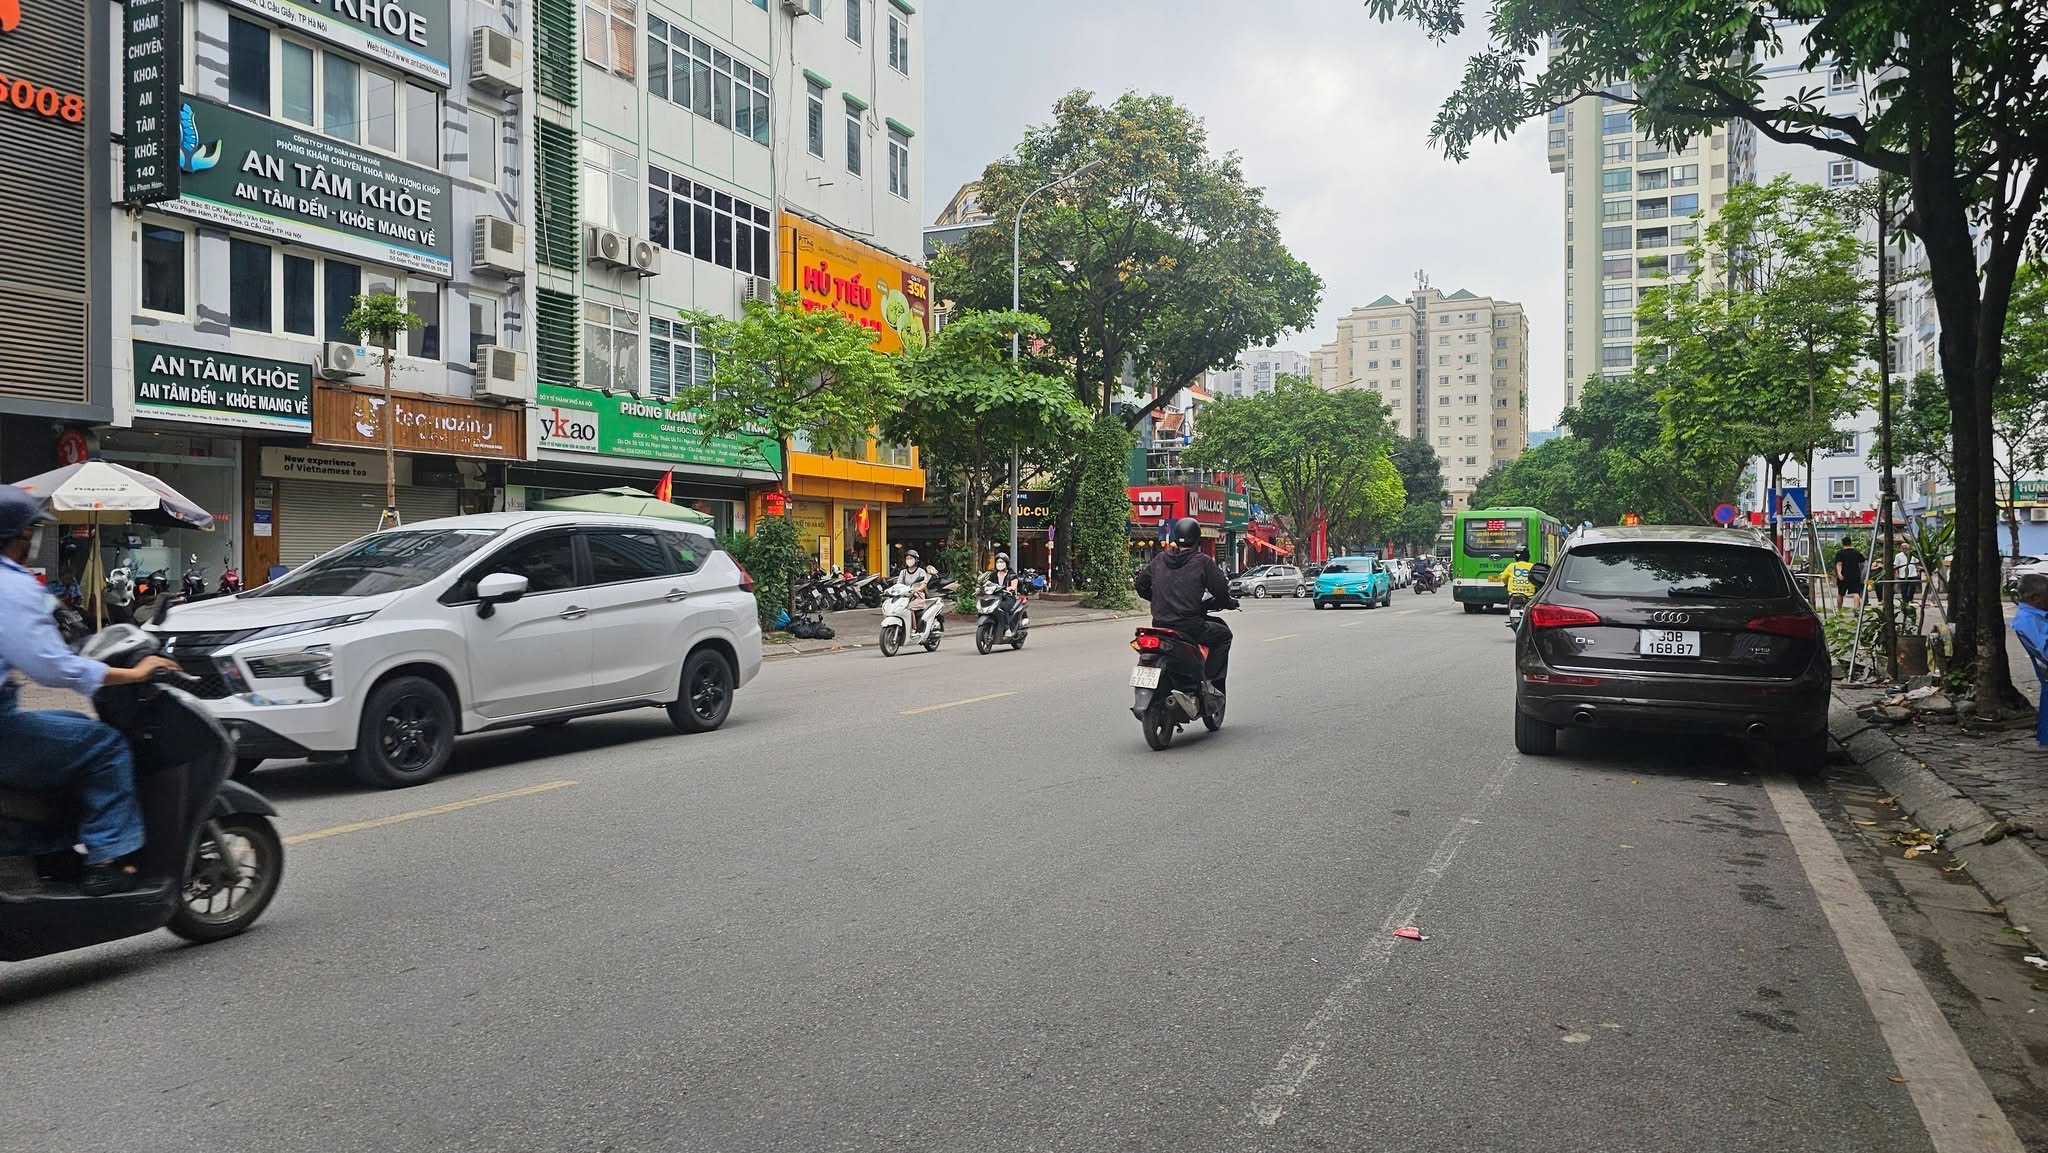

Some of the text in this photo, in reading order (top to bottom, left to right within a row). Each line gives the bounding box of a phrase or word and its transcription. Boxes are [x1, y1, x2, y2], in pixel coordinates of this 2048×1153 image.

[129, 37, 162, 59] CHUYÊN
[133, 66, 158, 84] KHOA
[139, 91, 152, 107] AN
[136, 116, 156, 133] TÂM
[136, 165, 155, 179] 140
[276, 139, 305, 156] PHÒNG
[306, 148, 330, 162] KHÁM
[331, 156, 361, 172] CHUYÊN
[362, 165, 384, 179] KHOA
[384, 172, 398, 184] NỘI
[398, 176, 422, 190] XƯƠNG
[241, 149, 432, 222] AN TÂM KHỎE
[235, 182, 258, 201] AN
[262, 187, 295, 211] TÂM
[299, 196, 328, 220] ĐẾN
[339, 208, 375, 232] KHỎE
[378, 219, 416, 243] MANG
[419, 227, 436, 247] VỀ
[804, 260, 831, 296] HỦ
[833, 272, 871, 310] TIẾU
[906, 279, 927, 300] 35K
[150, 354, 301, 391] AN TÂM KHỎE
[139, 382, 160, 399] AN
[162, 382, 190, 401] TÂM
[191, 384, 217, 405] ĐẾN
[226, 388, 257, 410] KHỎE
[258, 396, 292, 414] MANG
[294, 395, 309, 415] VỀ
[619, 400, 663, 419] PHÒNG
[540, 407, 596, 441] ykao
[660, 423, 676, 433] GIÁM
[284, 454, 356, 467] New experience
[284, 463, 367, 477] of Vietnamese tea
[1199, 498, 1223, 513] WALLACE
[1513, 565, 1529, 577] be
[1658, 631, 1683, 642] 30B
[1649, 642, 1693, 655] 168.87
